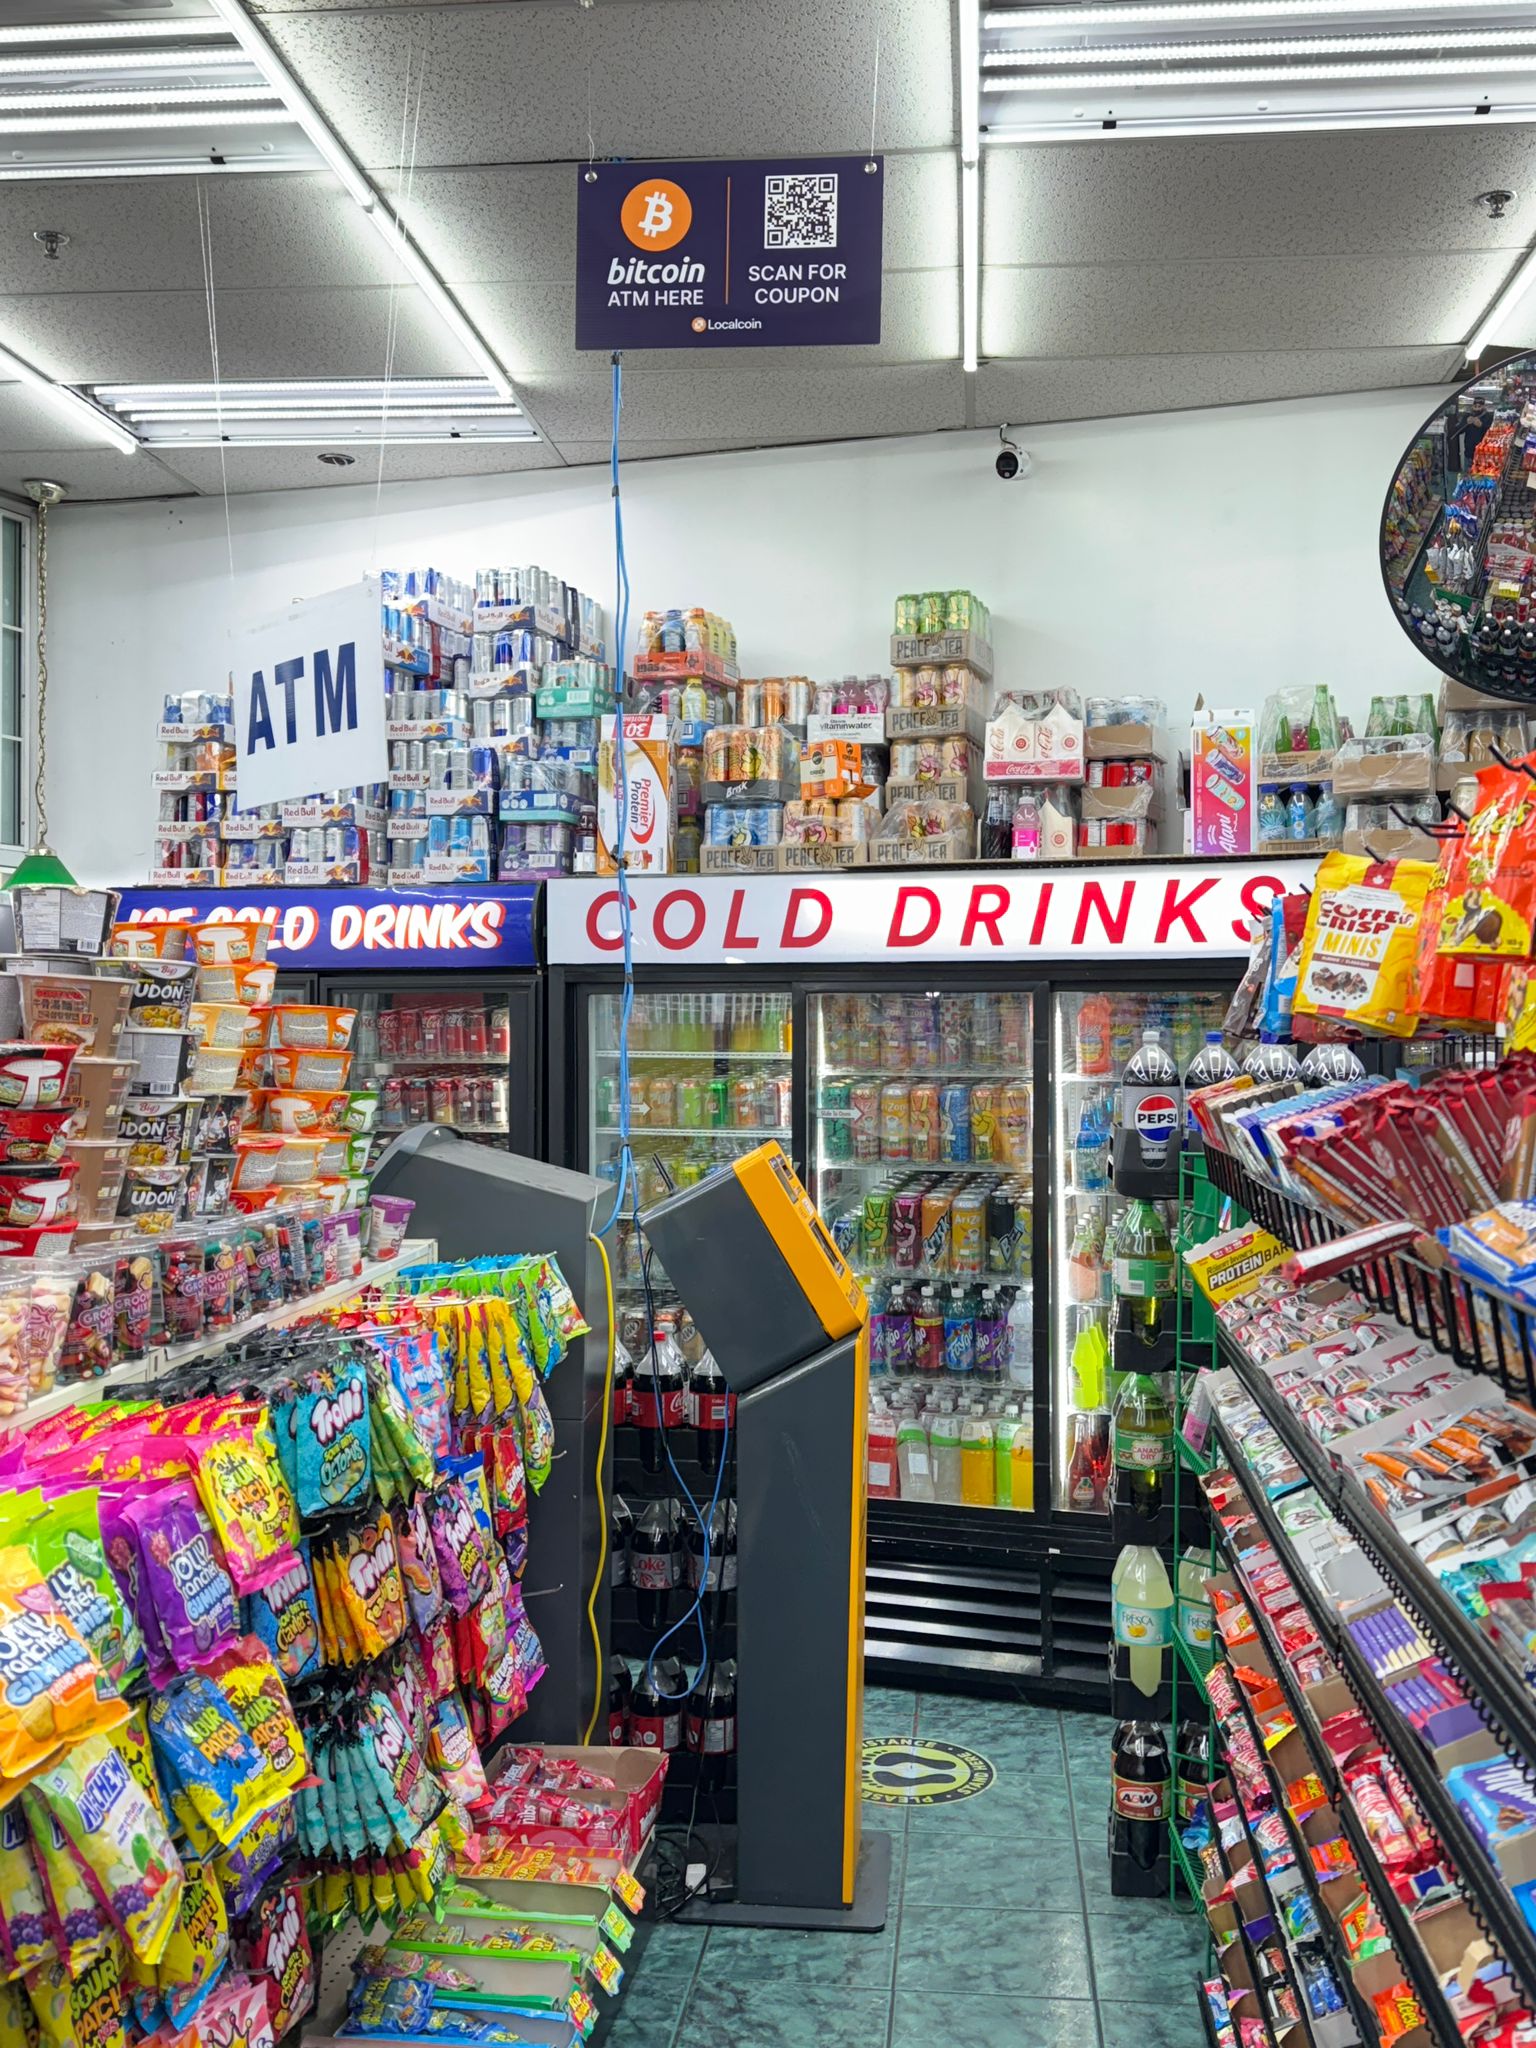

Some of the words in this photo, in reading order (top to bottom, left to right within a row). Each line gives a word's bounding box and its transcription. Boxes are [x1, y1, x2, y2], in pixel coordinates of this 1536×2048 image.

[607, 256, 705, 285] bitcoin
[748, 265, 803, 282] SCAN
[808, 263, 847, 280] FOR
[608, 290, 649, 307] ATM
[654, 289, 704, 306] HERE
[754, 286, 840, 304] COUPON
[708, 318, 762, 330] Localcoin
[943, 636, 963, 655] TEA
[247, 641, 358, 756] ATM
[892, 711, 927, 731] PEACE
[939, 709, 959, 727] TEA
[631, 780, 642, 824] Protein
[641, 778, 652, 830] Premier
[726, 780, 748, 799] Brisk
[283, 807, 300, 817] Red
[300, 806, 316, 817] Bull
[706, 853, 741, 868] PEACE
[754, 852, 774, 867] TEA
[785, 851, 820, 866] PEACE
[834, 848, 854, 864] TEA
[877, 843, 913, 861] PEACE
[928, 843, 948, 859] TEA
[287, 865, 303, 875] Red
[303, 865, 319, 875] Bull
[330, 901, 505, 949] DRINKS
[587, 888, 833, 950] COLD
[886, 876, 1287, 947] DRINKS
[1317, 914, 1391, 935] CRISP
[1321, 931, 1382, 959] MINIS
[134, 983, 184, 1000] UDON
[1137, 1112, 1177, 1124] PEPSI
[131, 1190, 177, 1206] UDON
[1209, 1252, 1263, 1290] PROTEIN
[1264, 1241, 1290, 1262] BAR
[948, 1329, 974, 1361] Faygo
[312, 1379, 365, 1446] Trolli
[320, 1442, 364, 1487] OCTOPUS
[1141, 1452, 1156, 1461] DRY
[227, 1480, 271, 1516] PATCH
[170, 1537, 210, 1584] JOLLY
[349, 1529, 394, 1598] Trolli
[181, 1560, 225, 1600] rancher
[1121, 1611, 1154, 1628] FRESCA
[6, 1641, 91, 1707] GUMMIES
[192, 1706, 225, 1744] SOUR
[252, 1710, 289, 1747] ATCH
[200, 1720, 242, 1766] PATCH
[76, 1748, 130, 1833] HI-CHEW
[1121, 1791, 1157, 1805] A&W
[267, 1895, 301, 1981] Trolli
[69, 1956, 120, 2020] SOUR
